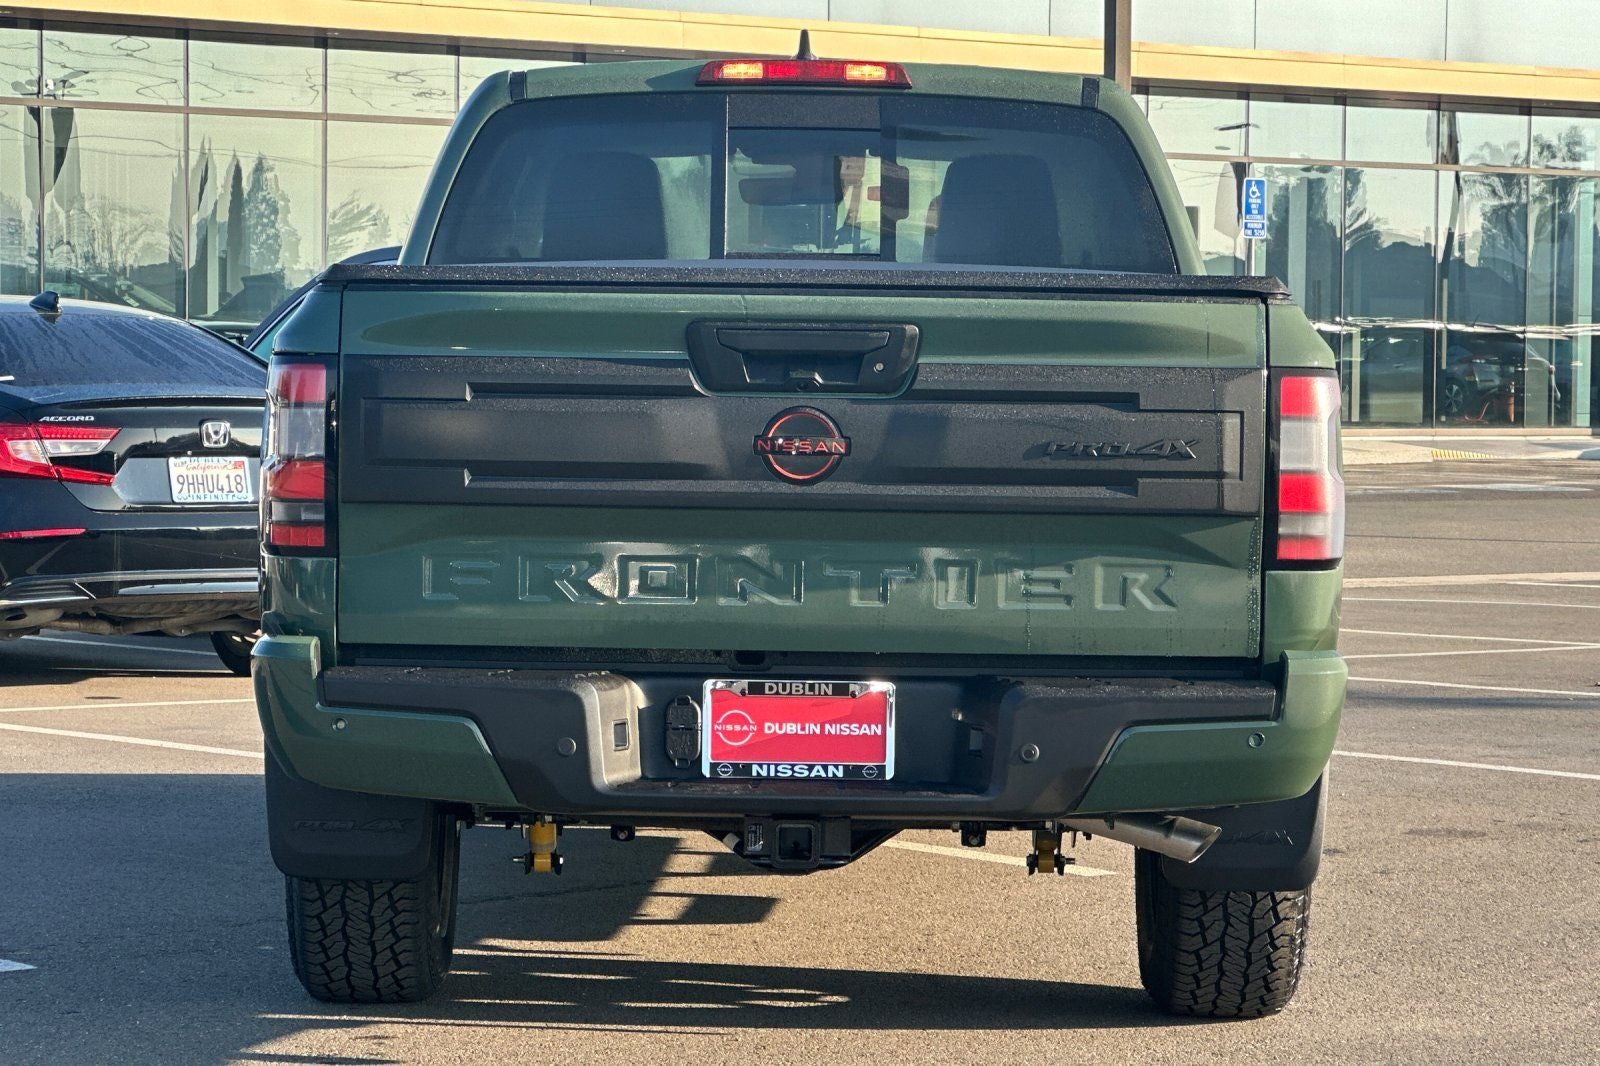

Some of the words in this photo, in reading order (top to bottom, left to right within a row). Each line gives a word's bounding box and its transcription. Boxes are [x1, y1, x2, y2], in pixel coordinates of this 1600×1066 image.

[757, 440, 846, 454] NISSAN
[176, 473, 244, 495] 9HHU418
[422, 552, 1178, 612] FRONTIER
[764, 682, 833, 696] DUBLIN
[714, 723, 757, 732] NISSAN
[763, 722, 821, 735] DUBLIN
[824, 723, 882, 736] NISSAN
[751, 763, 844, 778] NISSAN
